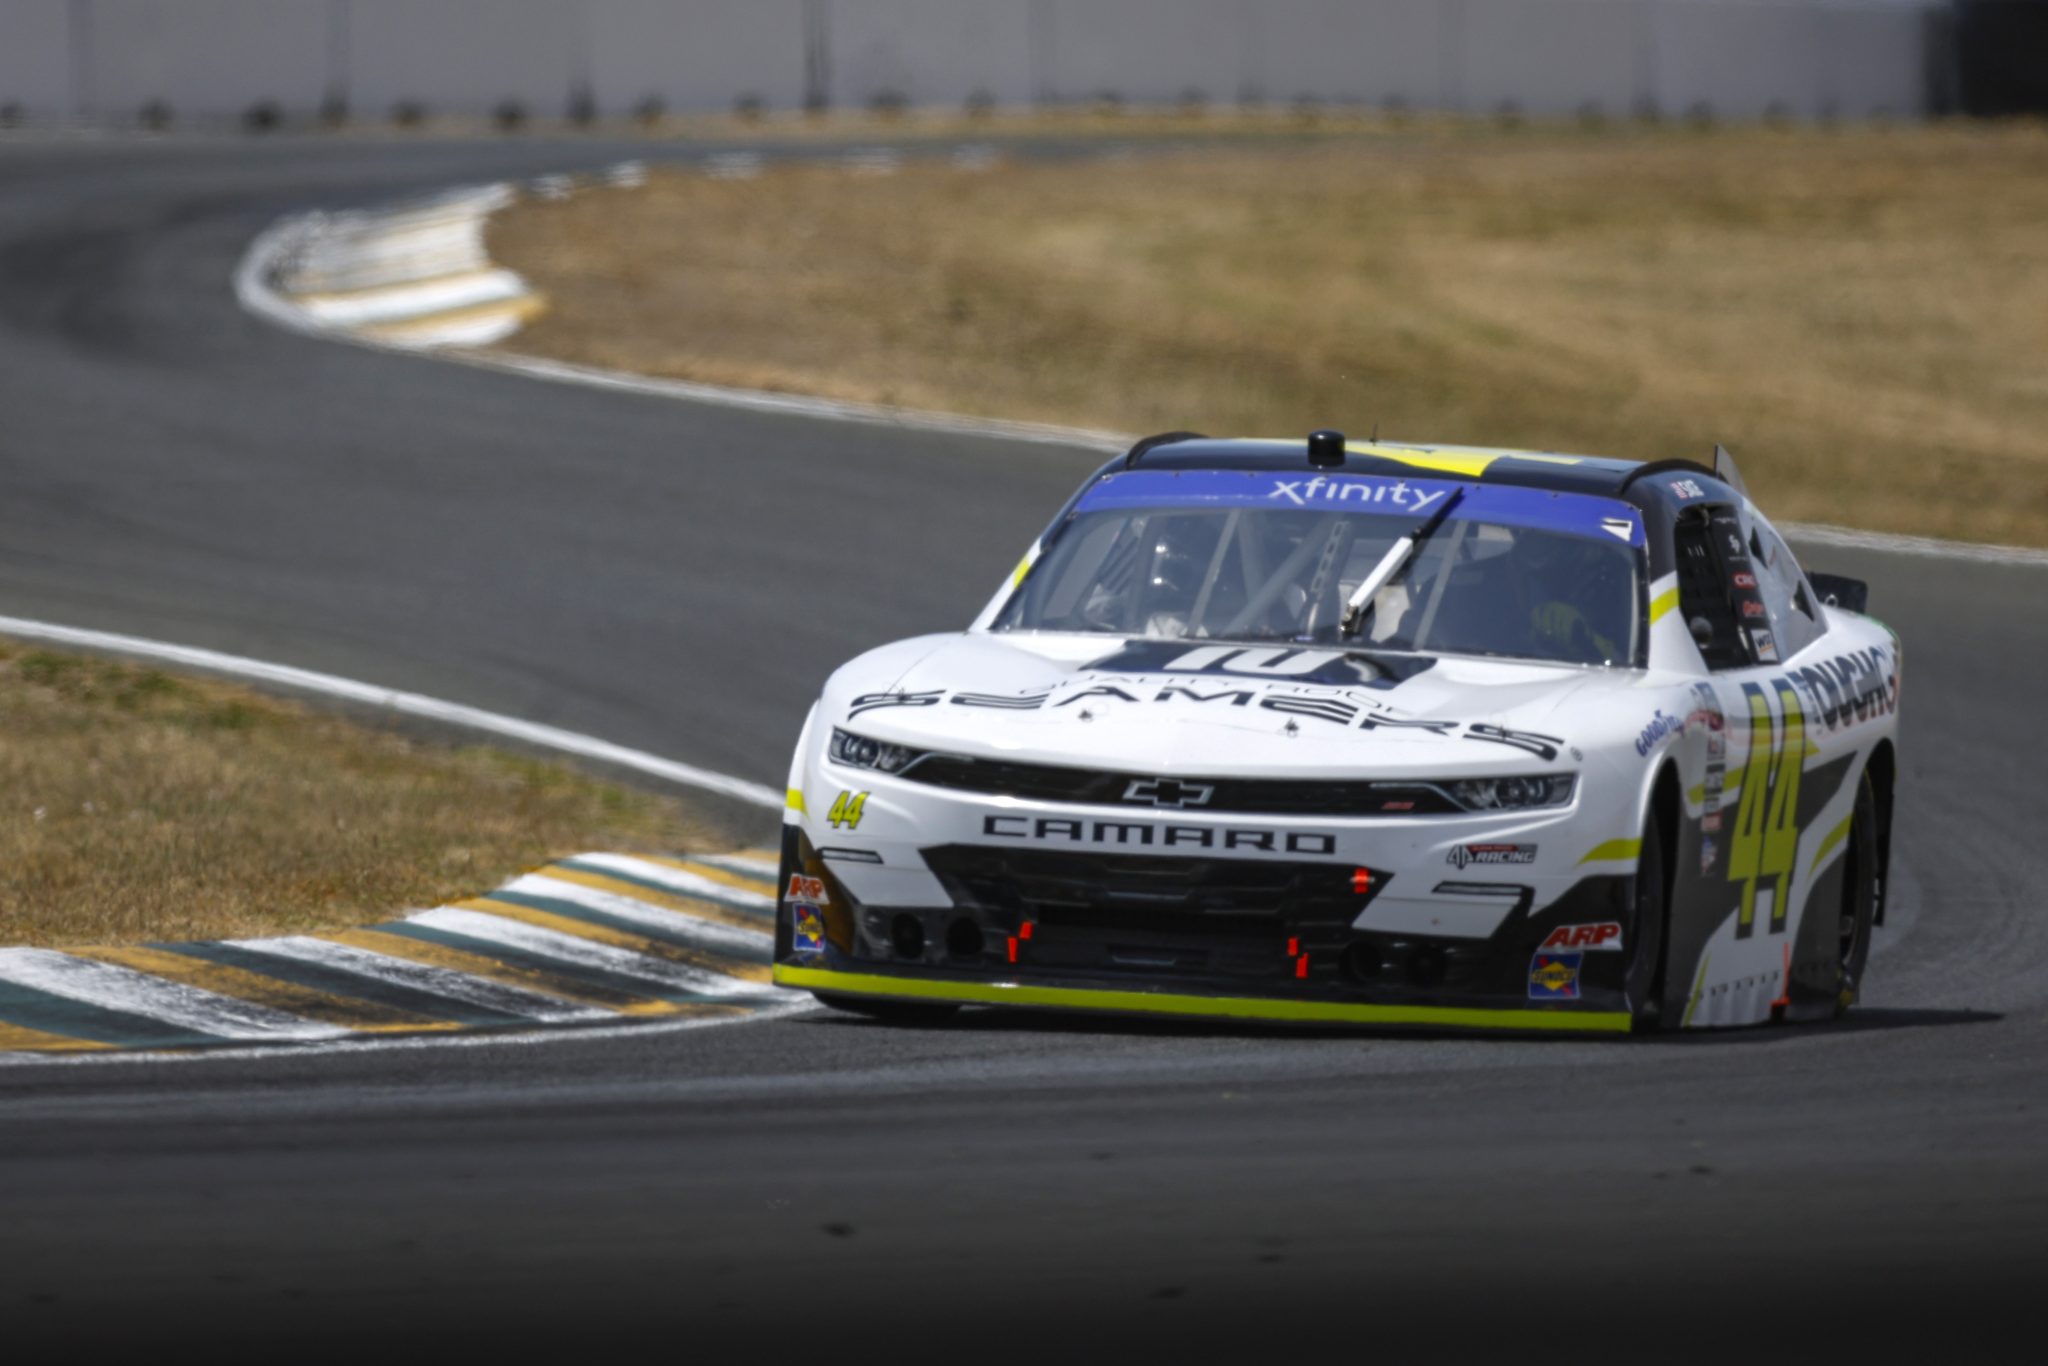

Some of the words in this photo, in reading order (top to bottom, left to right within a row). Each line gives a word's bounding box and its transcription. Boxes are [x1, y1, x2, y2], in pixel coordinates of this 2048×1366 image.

[1268, 476, 1446, 512] xfinity
[827, 790, 870, 829] 44
[1727, 678, 1804, 940] 44
[983, 815, 1336, 855] CAMARO
[1475, 850, 1535, 864] RACING
[789, 875, 823, 899] ARP
[1541, 925, 1620, 949] ARP
